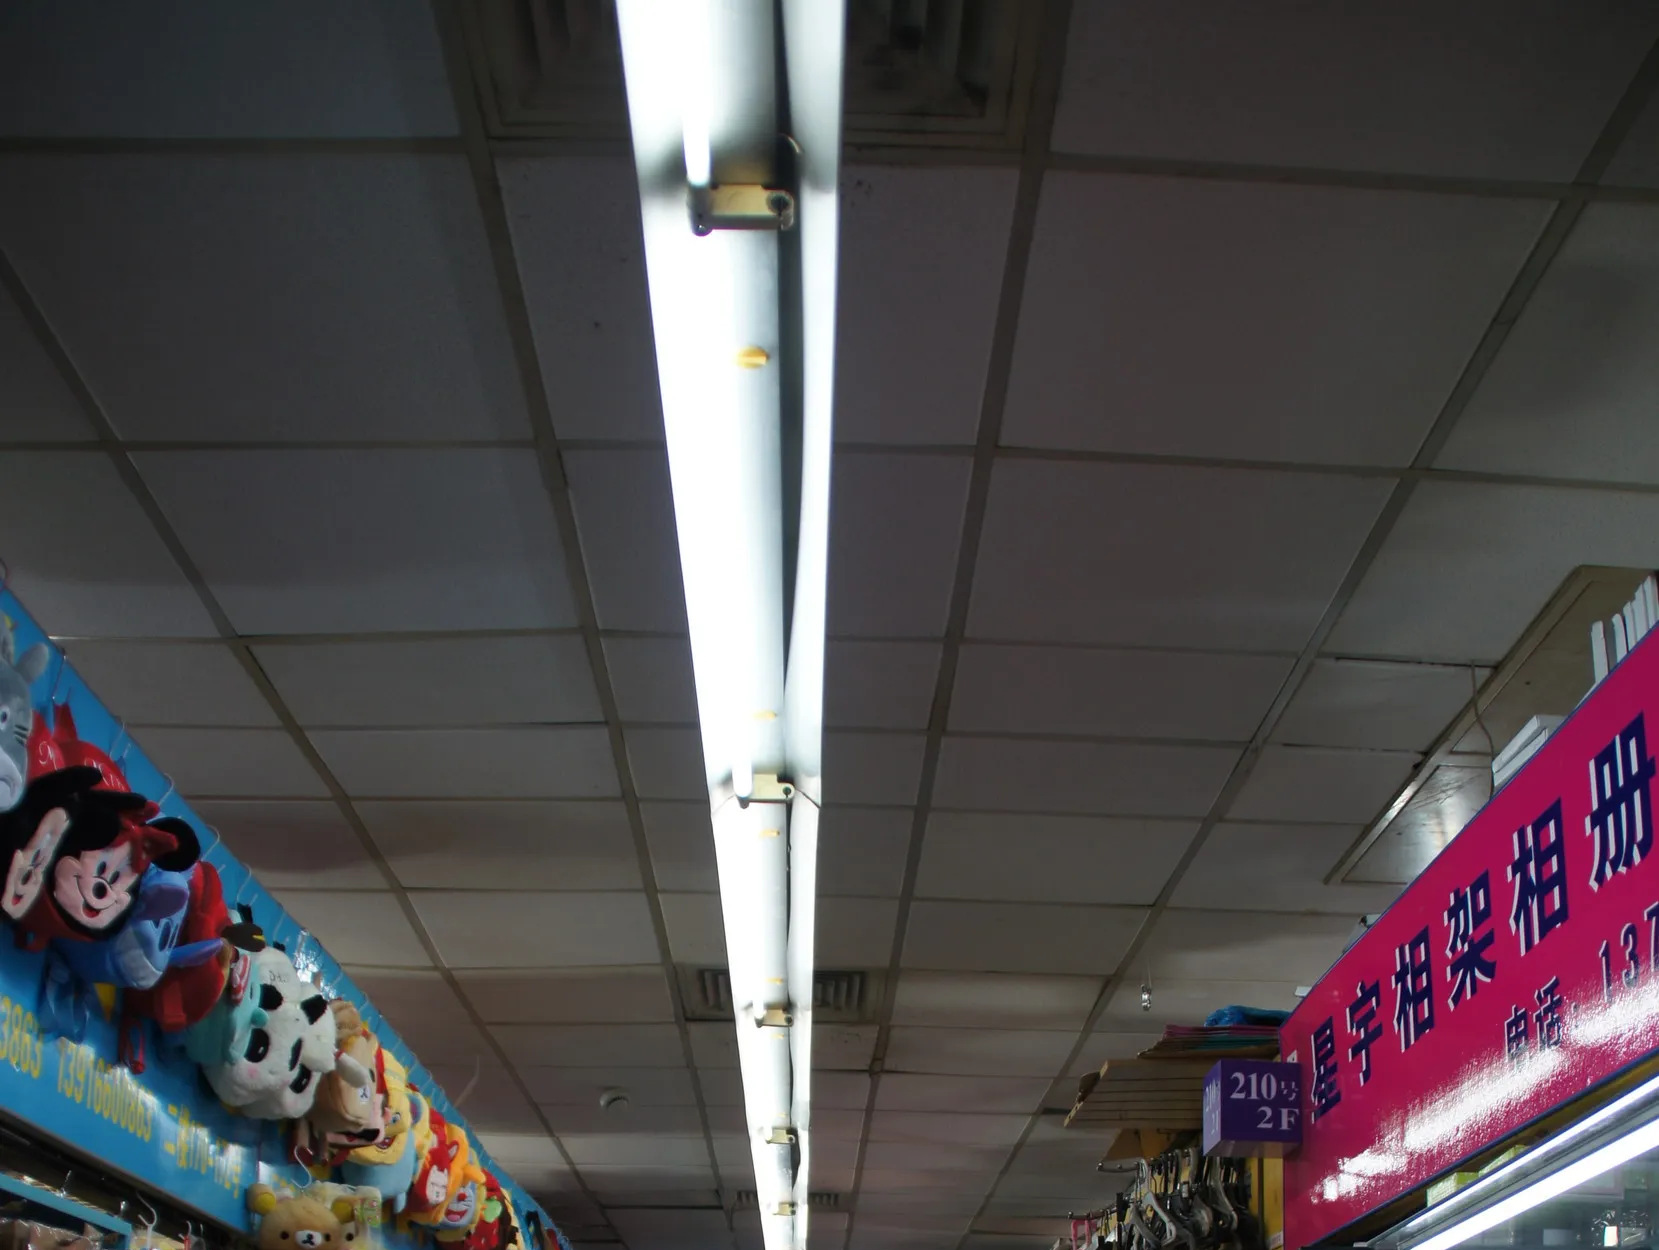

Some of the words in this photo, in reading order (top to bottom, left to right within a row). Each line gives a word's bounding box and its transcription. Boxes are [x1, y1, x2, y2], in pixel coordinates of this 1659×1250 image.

[1310, 710, 1656, 1124] 星宇相架相册
[1229, 1071, 1300, 1102] 210号
[1256, 1105, 1300, 1131] 2F
